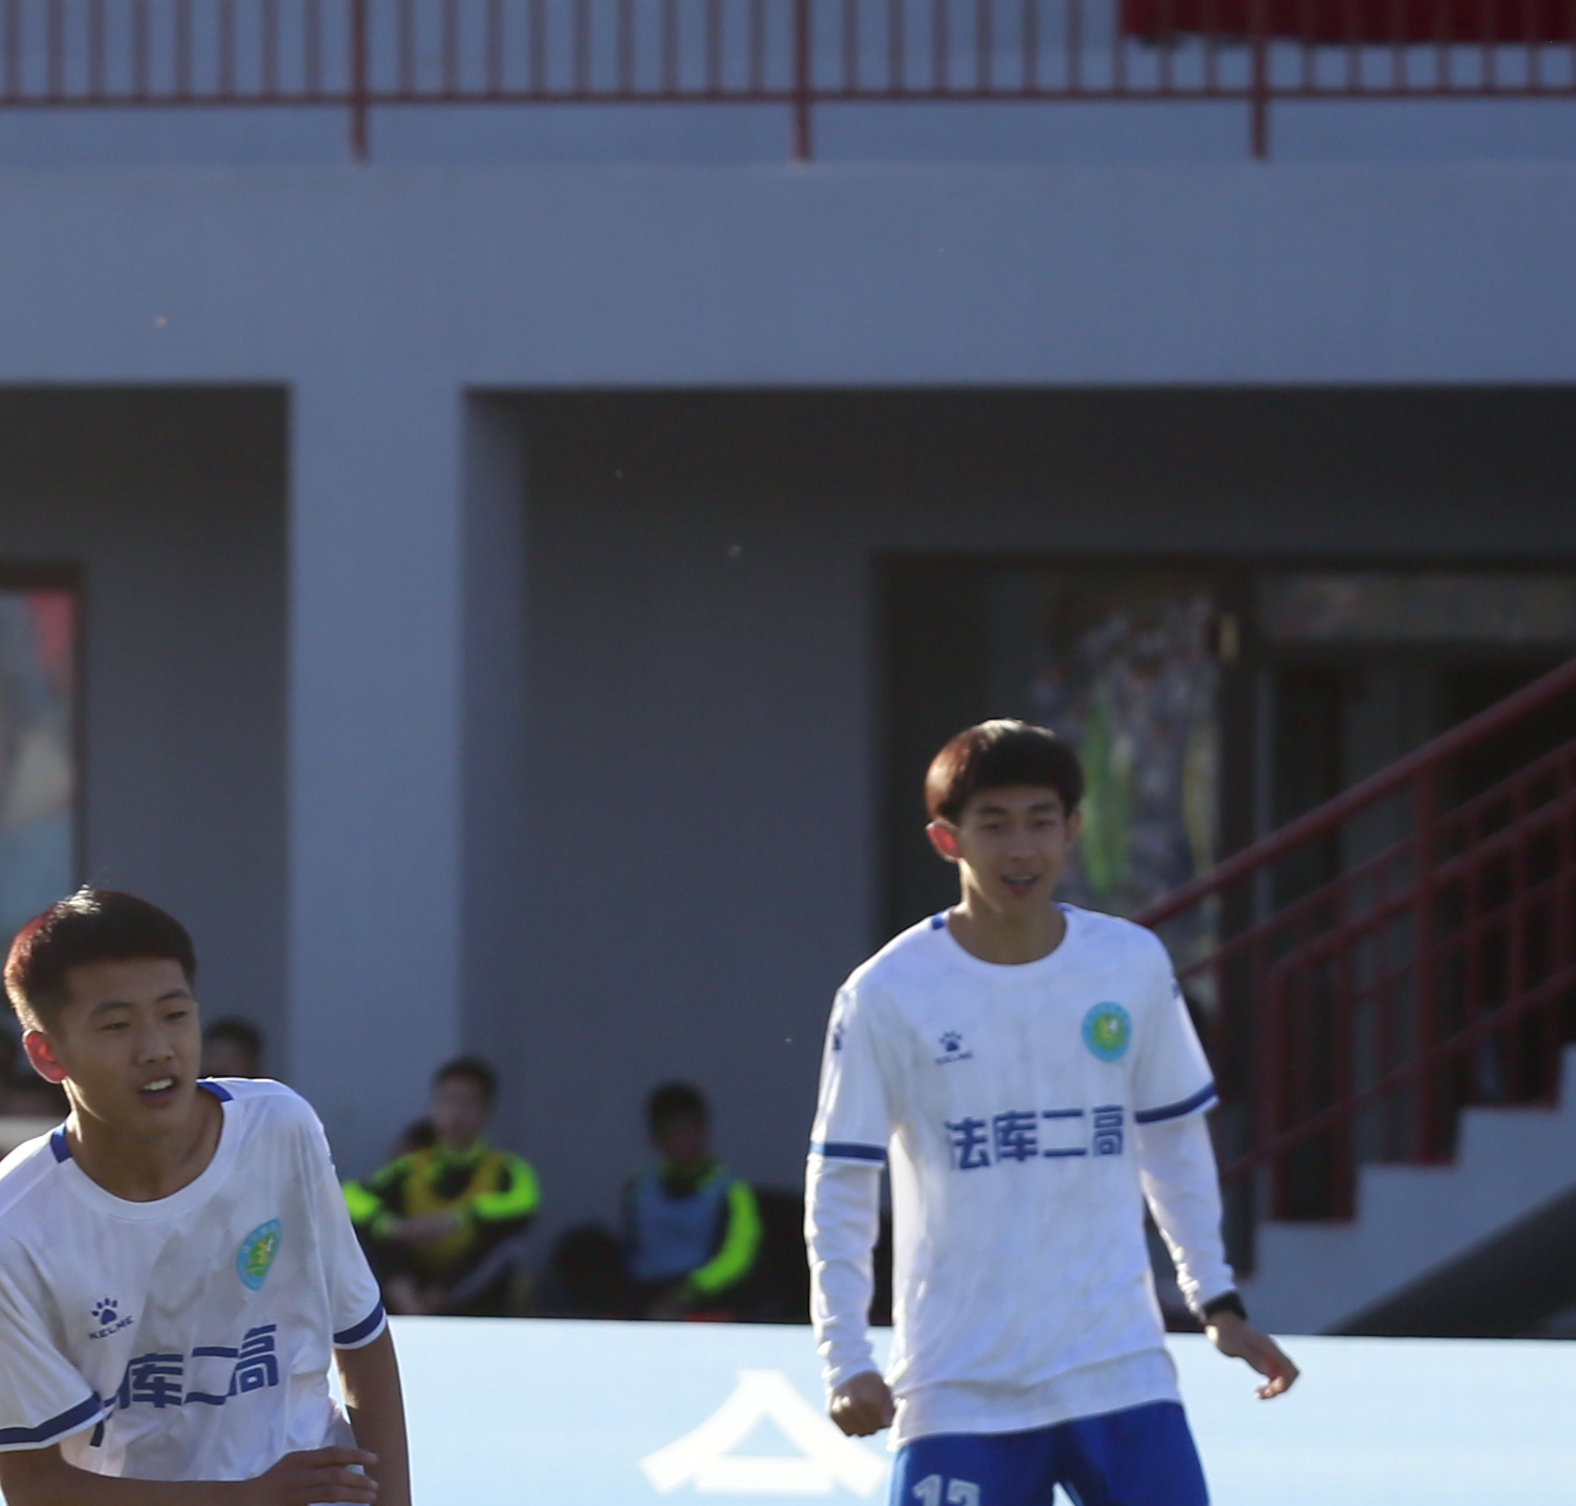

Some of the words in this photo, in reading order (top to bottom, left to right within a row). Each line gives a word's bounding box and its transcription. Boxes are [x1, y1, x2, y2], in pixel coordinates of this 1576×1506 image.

[944, 1104, 1124, 1169] 法库二高
[88, 1315, 133, 1340] KELME
